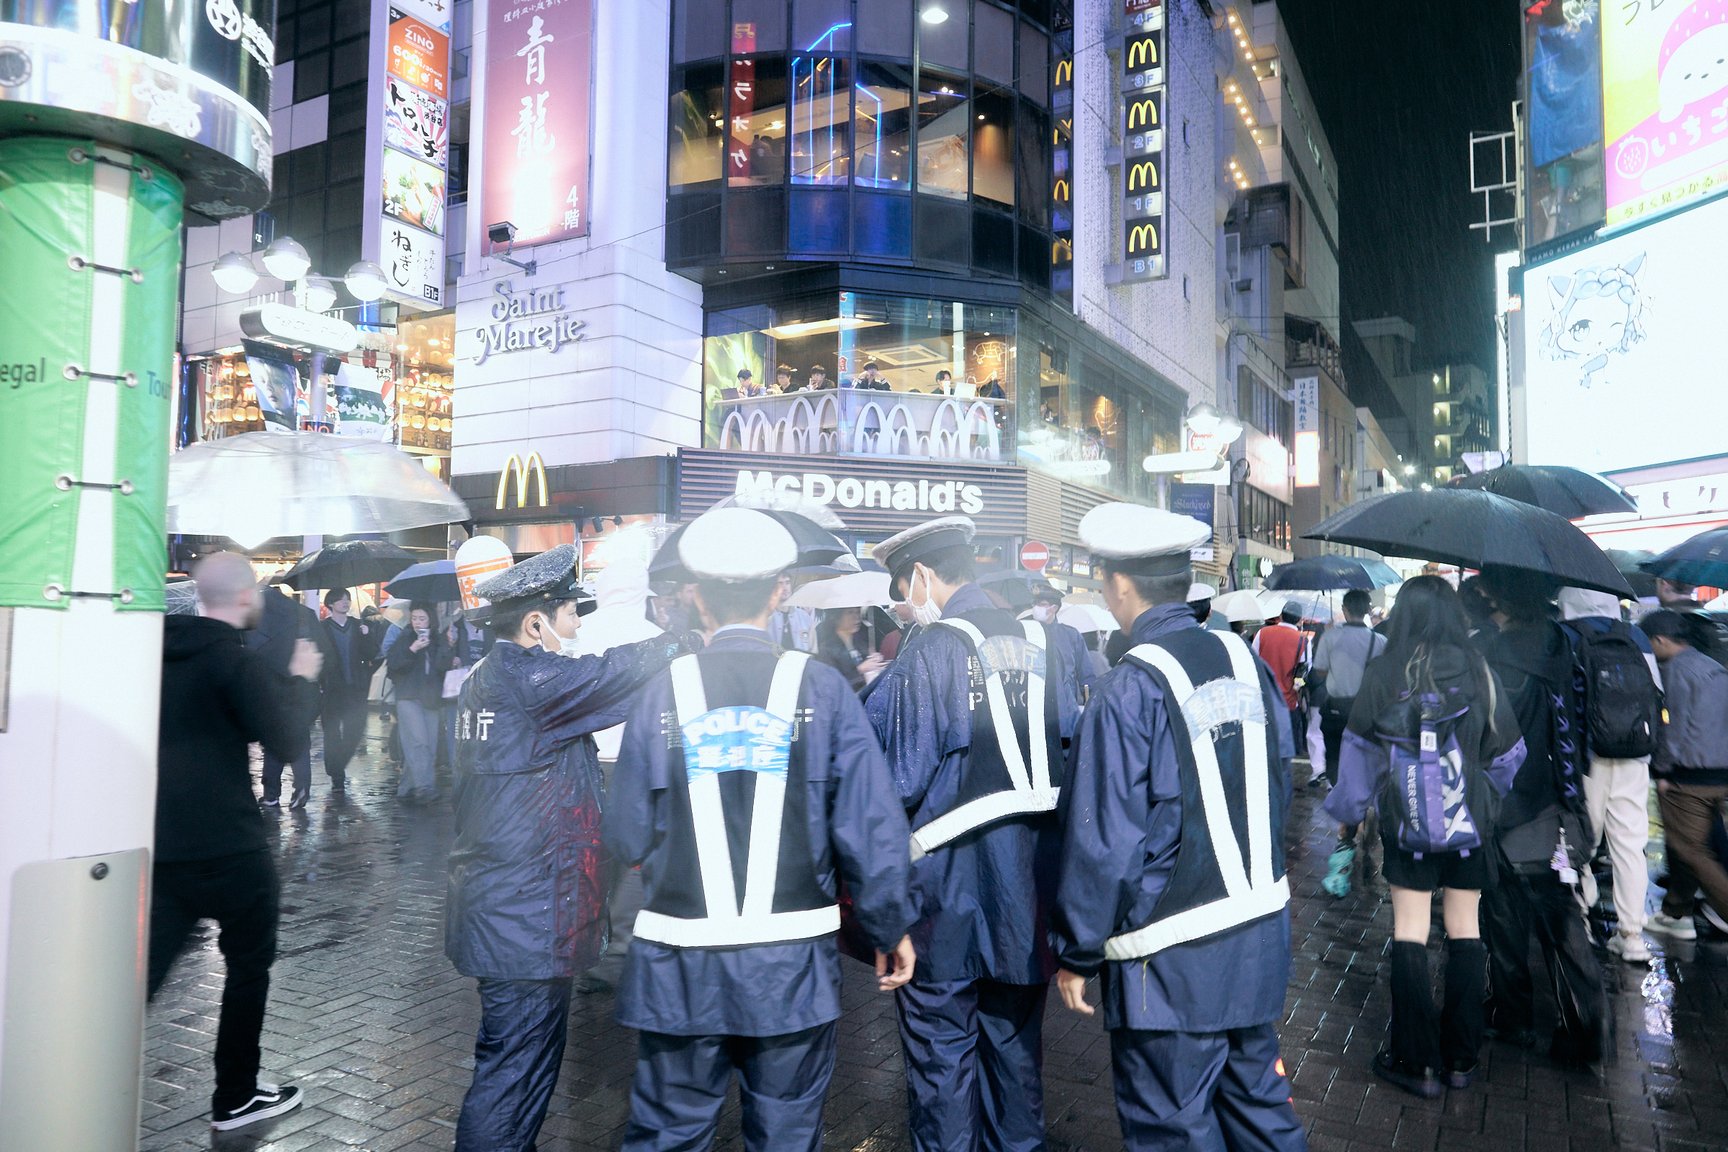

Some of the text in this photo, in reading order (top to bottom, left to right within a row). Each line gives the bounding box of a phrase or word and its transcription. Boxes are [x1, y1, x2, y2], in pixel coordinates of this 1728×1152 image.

[1133, 13, 1154, 26] 4F
[404, 28, 435, 51] ZINO
[1133, 74, 1154, 88] 3F
[1134, 136, 1154, 149] 2F
[384, 199, 403, 216] 2F
[564, 185, 580, 230] 4階
[1134, 198, 1154, 211] 1F
[391, 230, 412, 287] ねぎし
[1134, 259, 1156, 273] B1
[424, 285, 438, 300] B1F
[491, 280, 566, 322] Saint
[735, 470, 984, 515] McDonald's
[1407, 764, 1417, 797] NEVER
